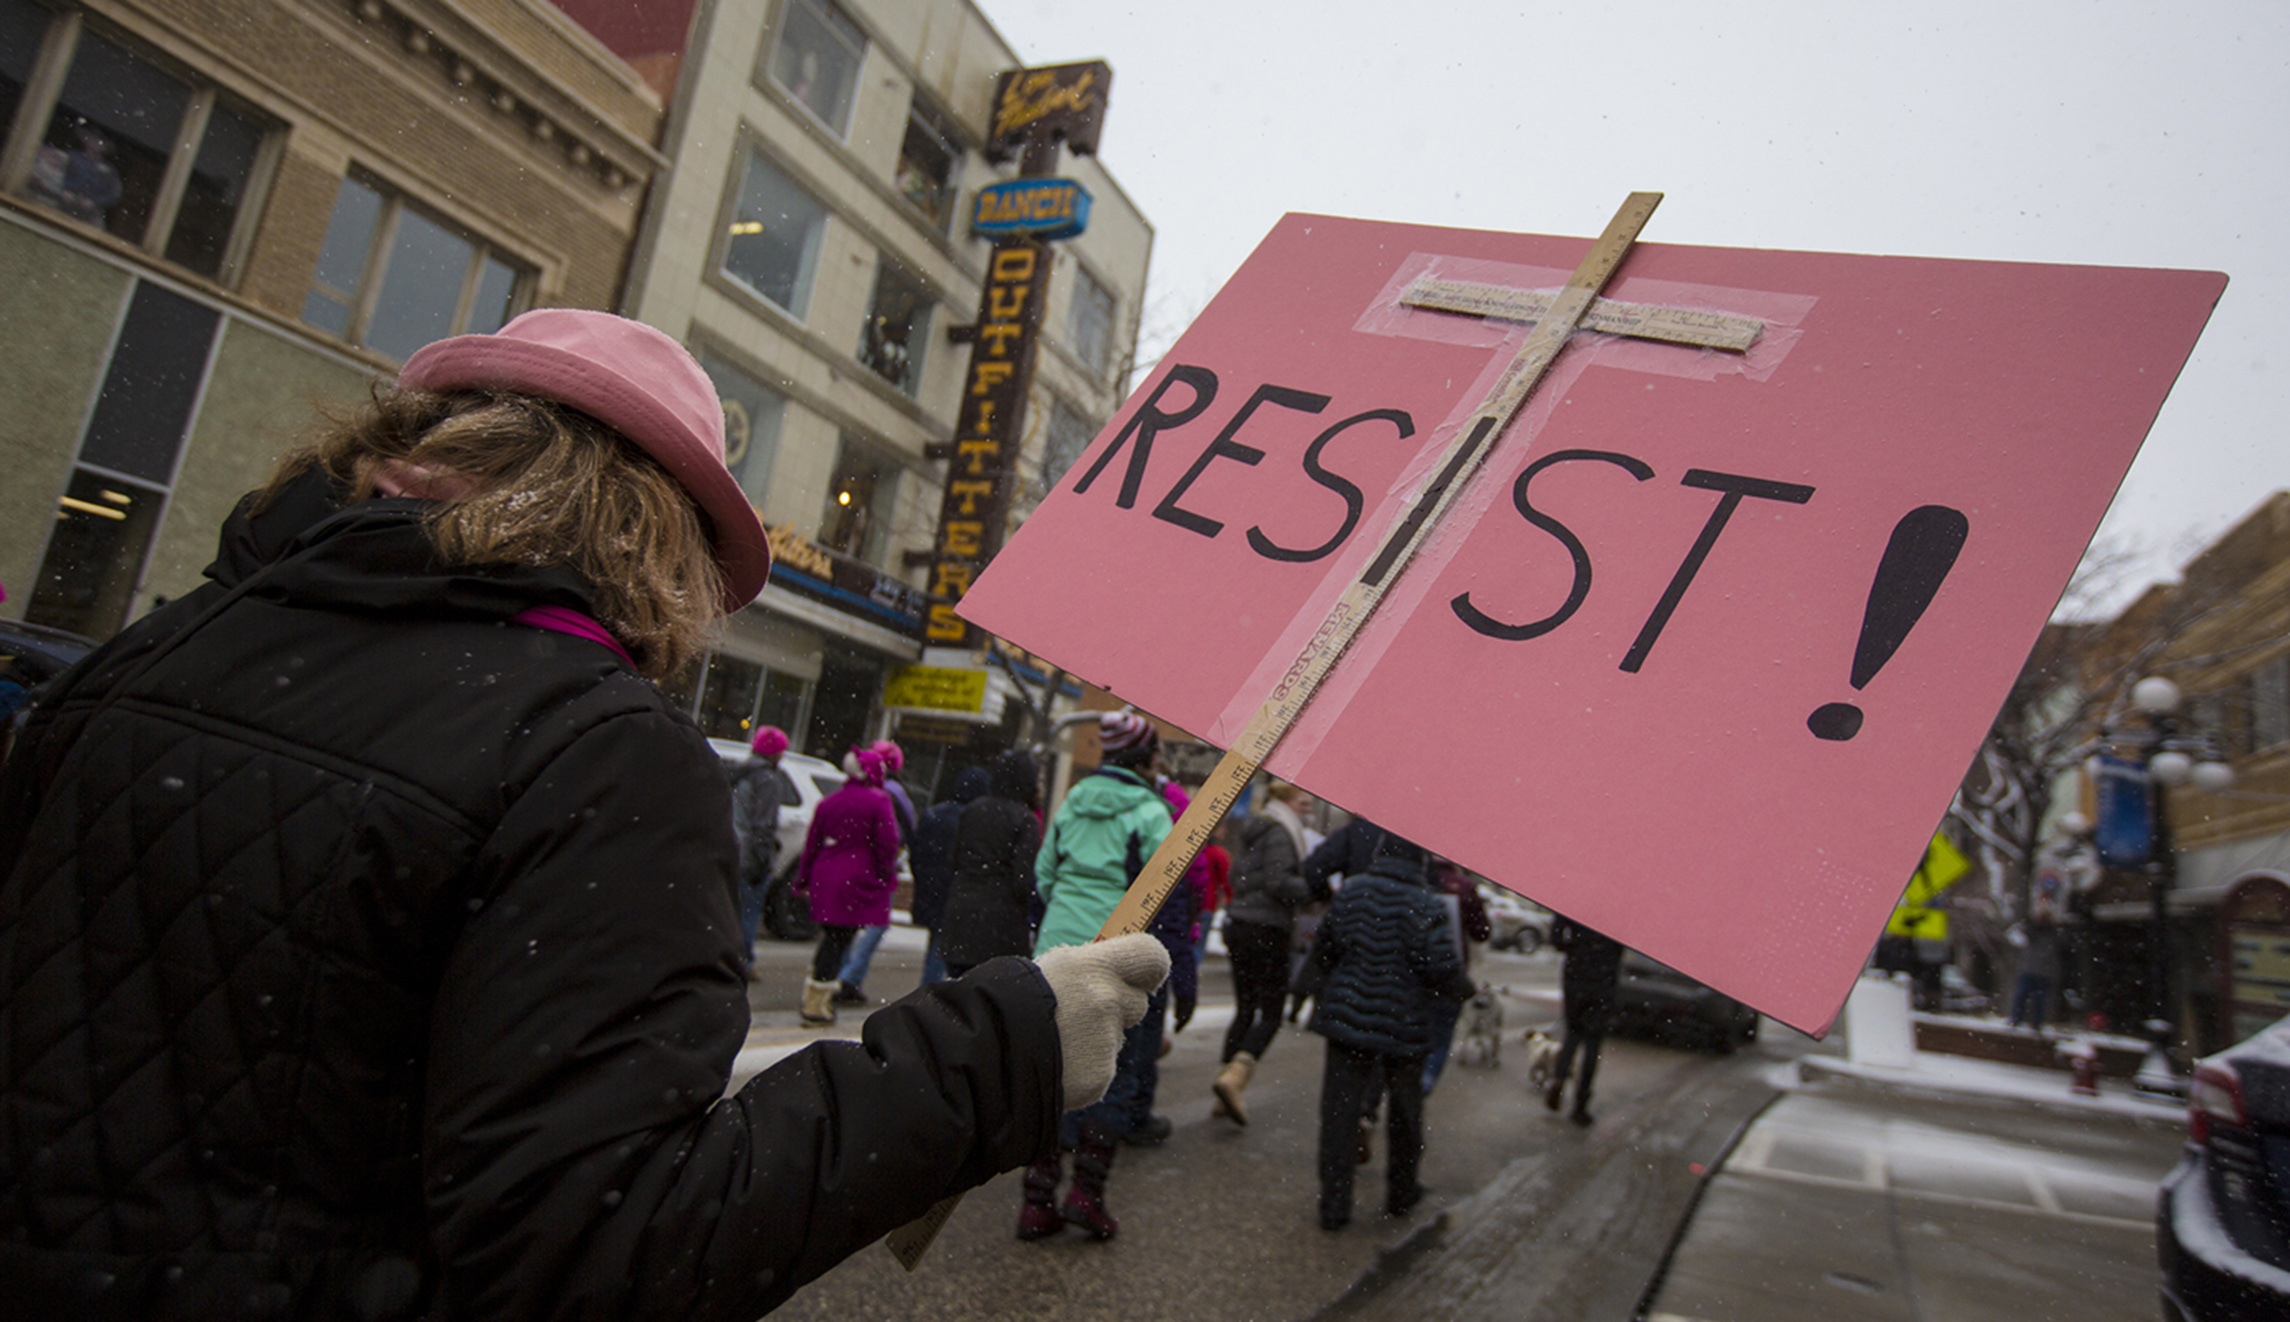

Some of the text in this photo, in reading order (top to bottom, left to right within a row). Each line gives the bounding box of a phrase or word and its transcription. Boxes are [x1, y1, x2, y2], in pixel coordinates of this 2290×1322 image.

[978, 188, 1076, 221] RANCH
[926, 248, 1036, 641] OUTFITTERS
[1272, 602, 1352, 702] MENARDS
